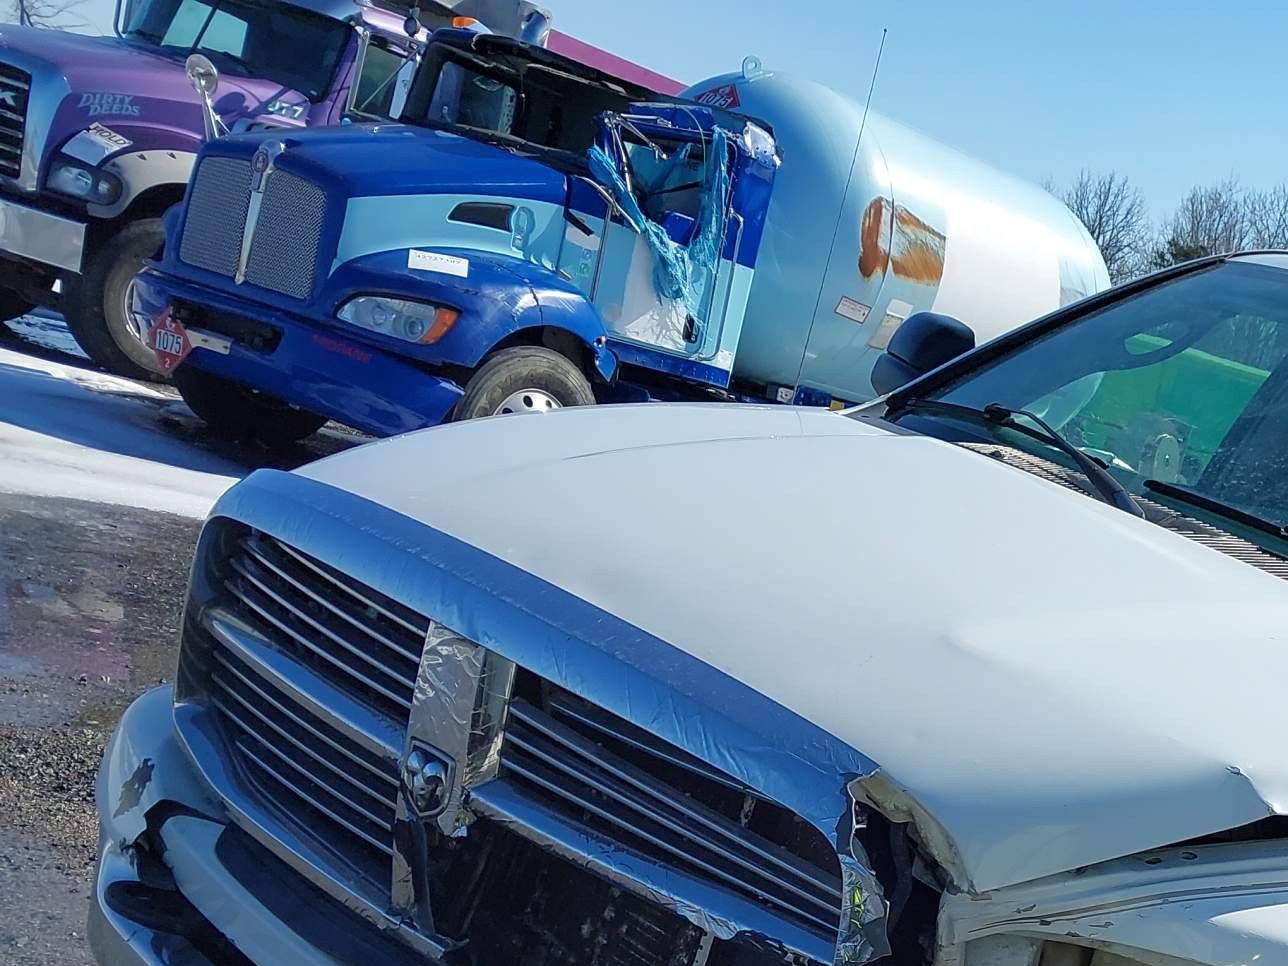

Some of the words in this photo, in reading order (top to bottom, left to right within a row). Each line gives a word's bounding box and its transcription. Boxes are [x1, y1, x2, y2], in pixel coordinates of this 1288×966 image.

[78, 93, 134, 108] DIRTY
[699, 92, 733, 108] 1075
[88, 103, 139, 116] DEEDS
[92, 125, 127, 145] HOLD
[157, 331, 182, 354] 1075
[164, 358, 170, 368] 2
